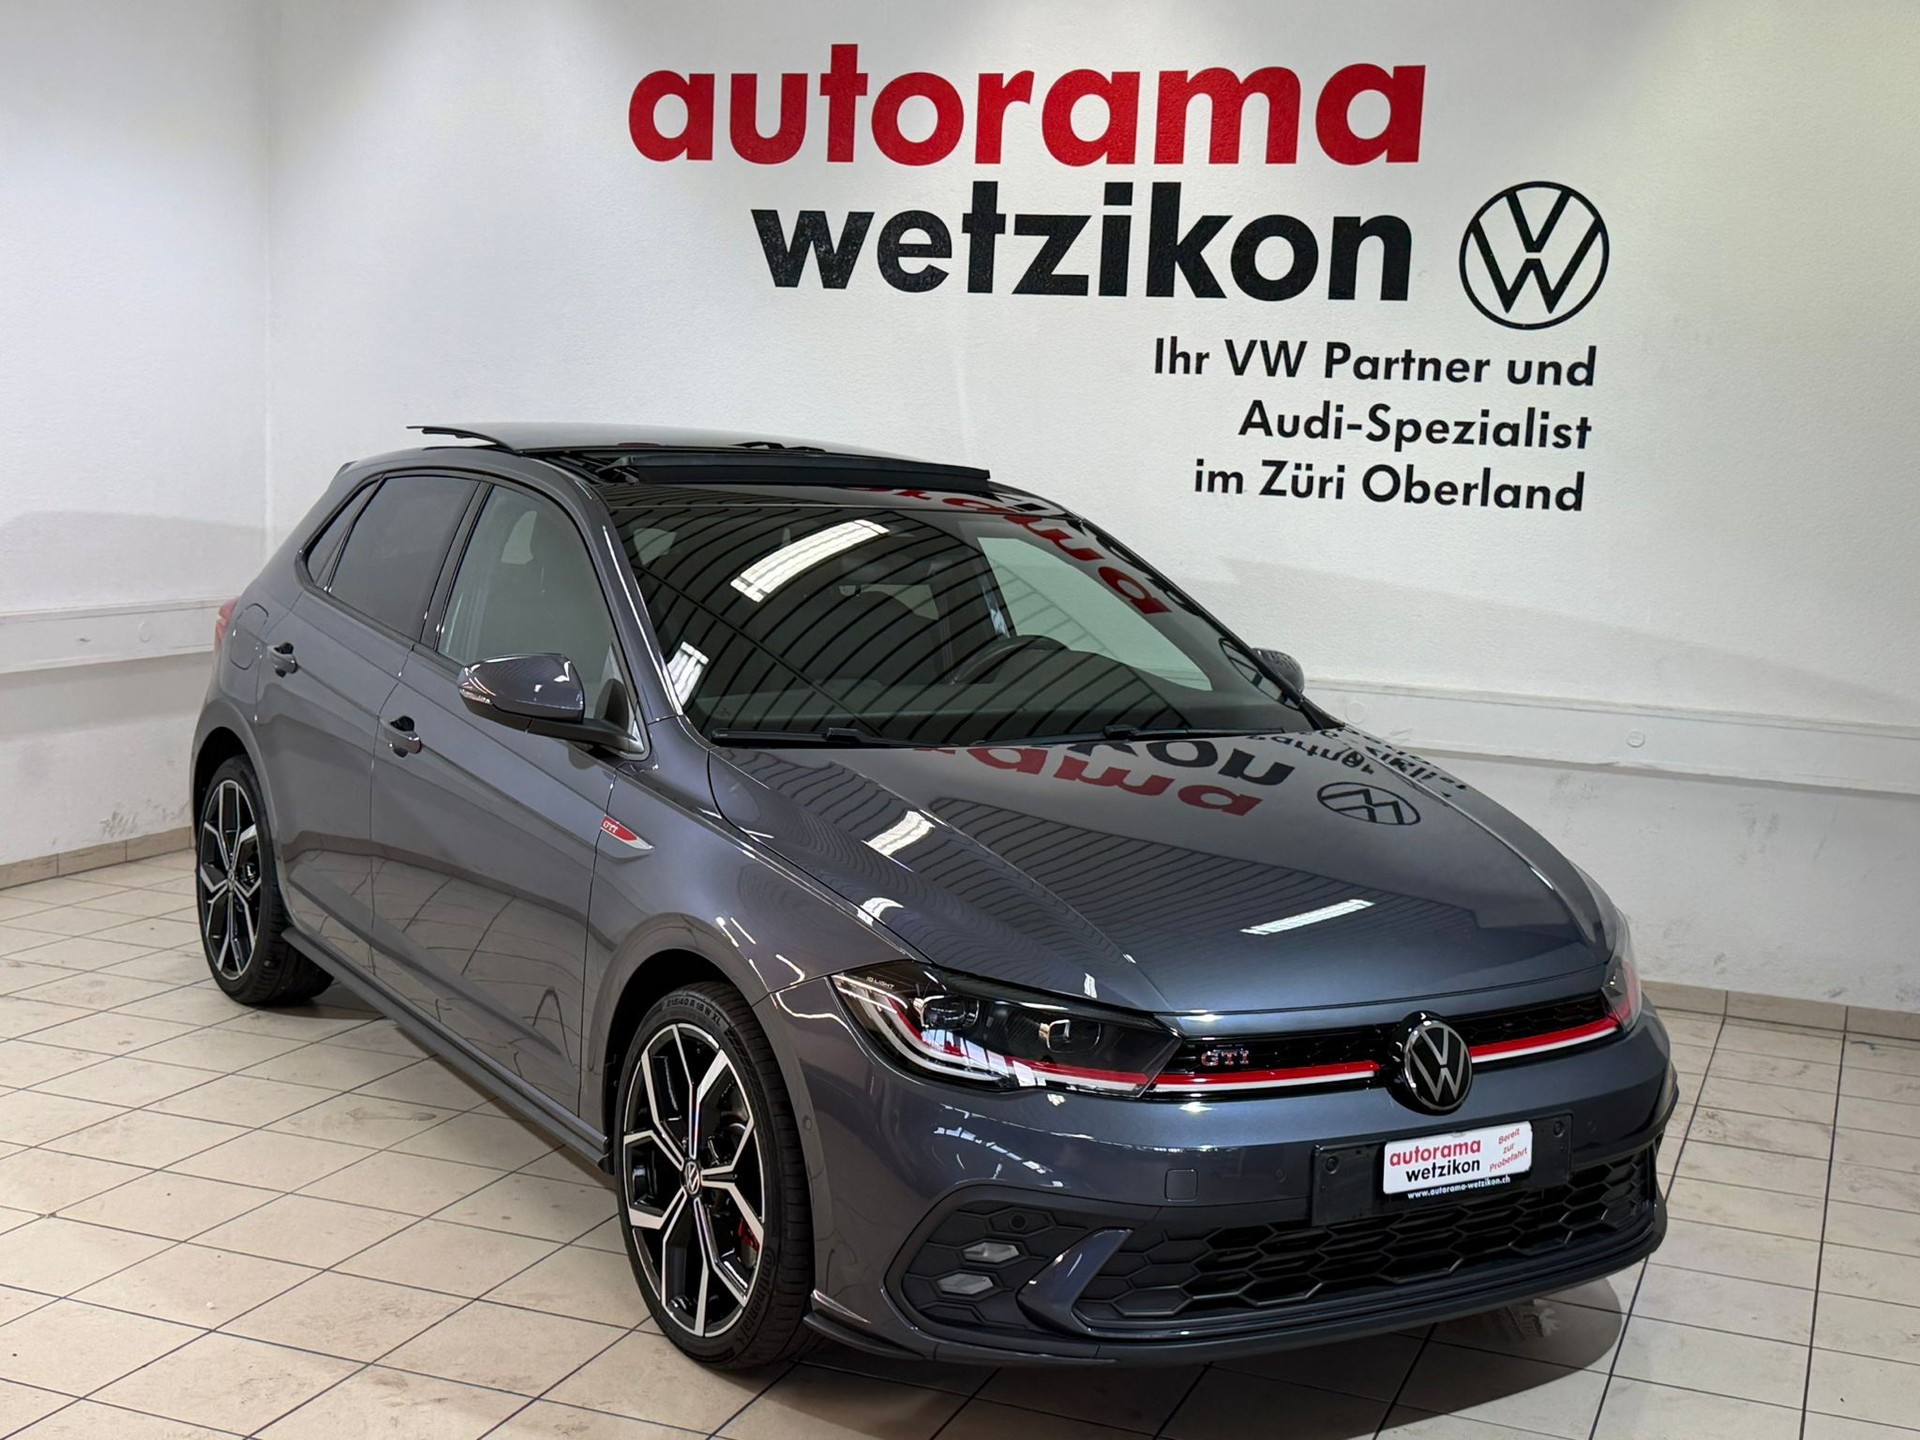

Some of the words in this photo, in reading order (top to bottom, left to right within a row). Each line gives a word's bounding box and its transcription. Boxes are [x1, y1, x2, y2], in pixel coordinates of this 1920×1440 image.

[629, 44, 1426, 167] autorama
[751, 181, 1412, 302] wetzikon
[1459, 181, 1610, 331] VW
[1154, 336, 1210, 375] Ihr
[1225, 339, 1308, 378] VW
[1325, 342, 1490, 383] Partner
[1508, 346, 1597, 387] und
[1239, 399, 1593, 456] Audi-Spezialist
[1194, 458, 1244, 495] im
[1258, 460, 1345, 500] Züri
[1362, 464, 1585, 512] Oberland
[1201, 1048, 1250, 1067] GTI
[1404, 1020, 1472, 1111] VW
[1389, 1139, 1481, 1167] autorama
[1497, 1128, 1520, 1145] Bereit
[1502, 1143, 1515, 1155] zur
[1405, 1159, 1481, 1183] wetzikon
[1489, 1146, 1528, 1173] Probefahrt
[1407, 1174, 1511, 1200] www.autorama-wetzikon.ch
